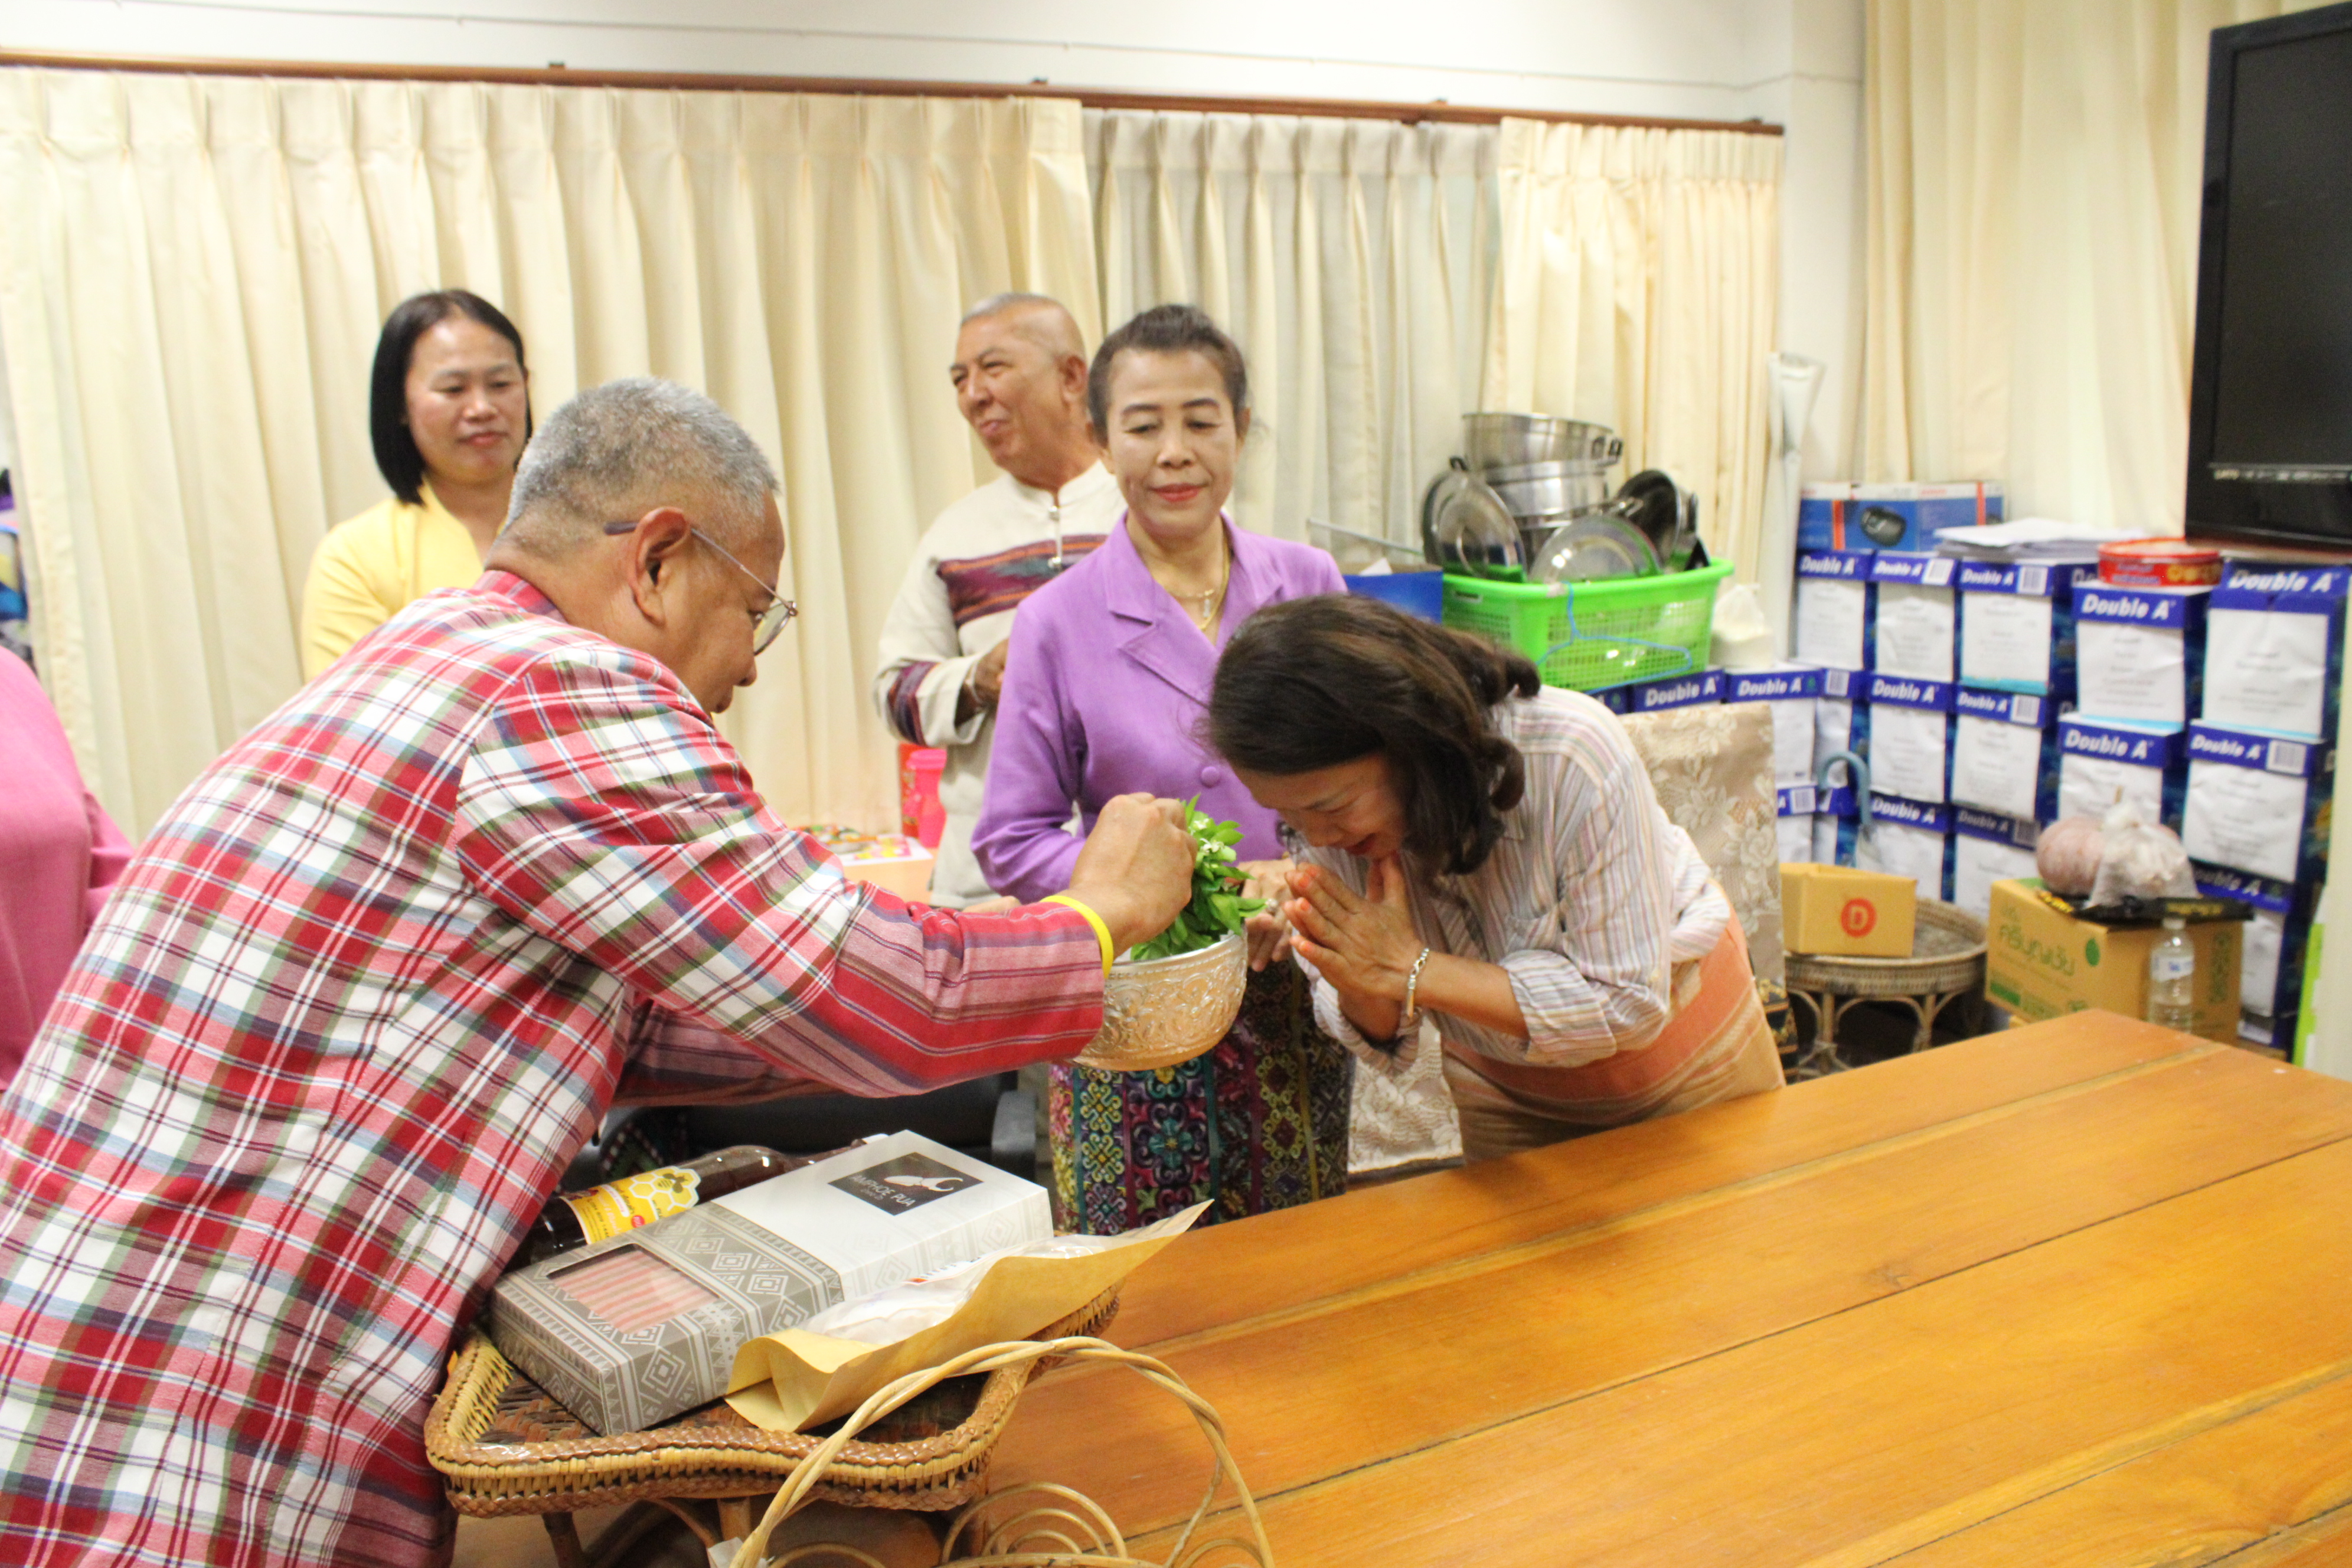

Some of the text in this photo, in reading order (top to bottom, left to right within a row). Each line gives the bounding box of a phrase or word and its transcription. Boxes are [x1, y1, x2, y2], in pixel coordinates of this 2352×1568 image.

[1801, 556, 1854, 574] Double A
[1874, 561, 1922, 576] Double A
[1962, 569, 2014, 584] Double A
[2229, 570, 2333, 592] Double A
[2082, 594, 2169, 620] Double A
[1646, 678, 1716, 705] Double A
[1739, 677, 1801, 697] Double A
[1873, 680, 1935, 702] Double A
[1958, 692, 2008, 713] Double A
[2066, 730, 2148, 760] Double A
[2192, 735, 2261, 760] Double A
[1872, 799, 1935, 823] Double A
[1958, 811, 1995, 829] Double
[891, 1193, 916, 1207] PUA
